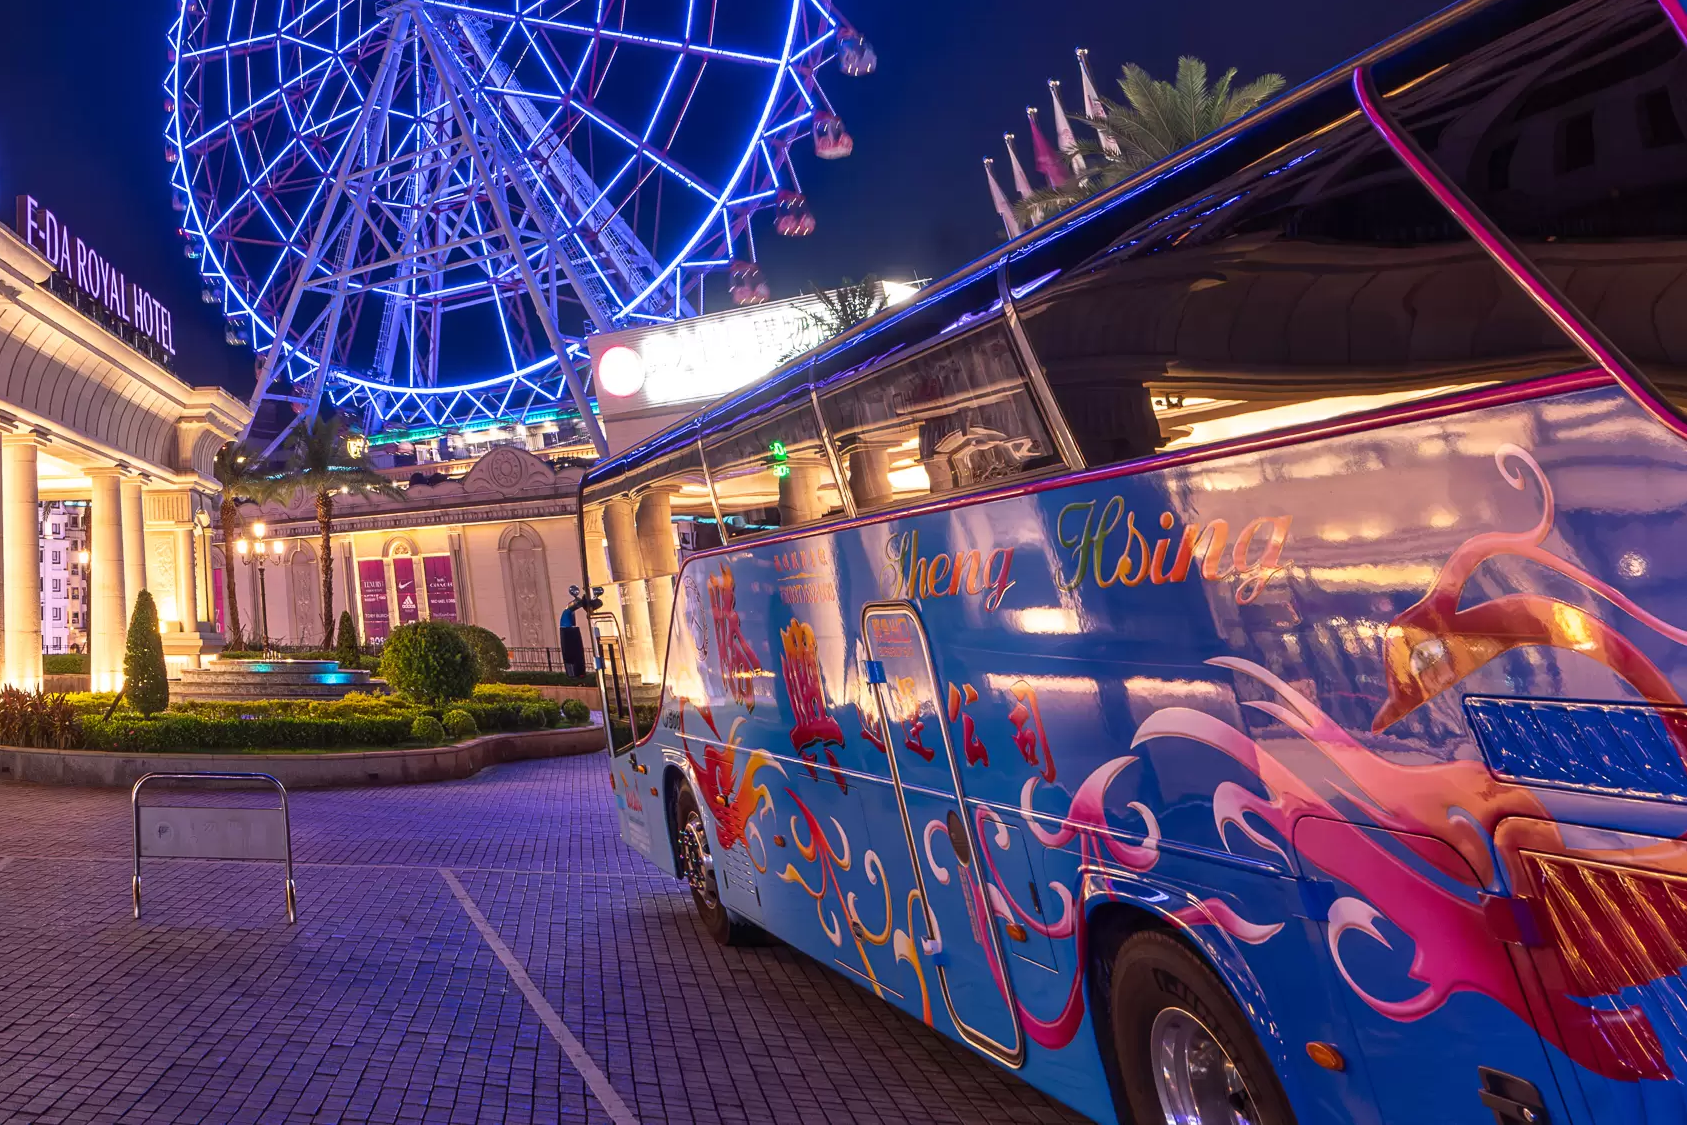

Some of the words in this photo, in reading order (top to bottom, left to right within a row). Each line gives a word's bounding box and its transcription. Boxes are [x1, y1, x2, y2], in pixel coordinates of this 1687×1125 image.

[27, 195, 73, 280] E-DA
[76, 236, 130, 321] ROYAL
[133, 283, 176, 355] HOTEL
[880, 529, 1016, 612] Sheng
[1055, 495, 1295, 605] Hsing
